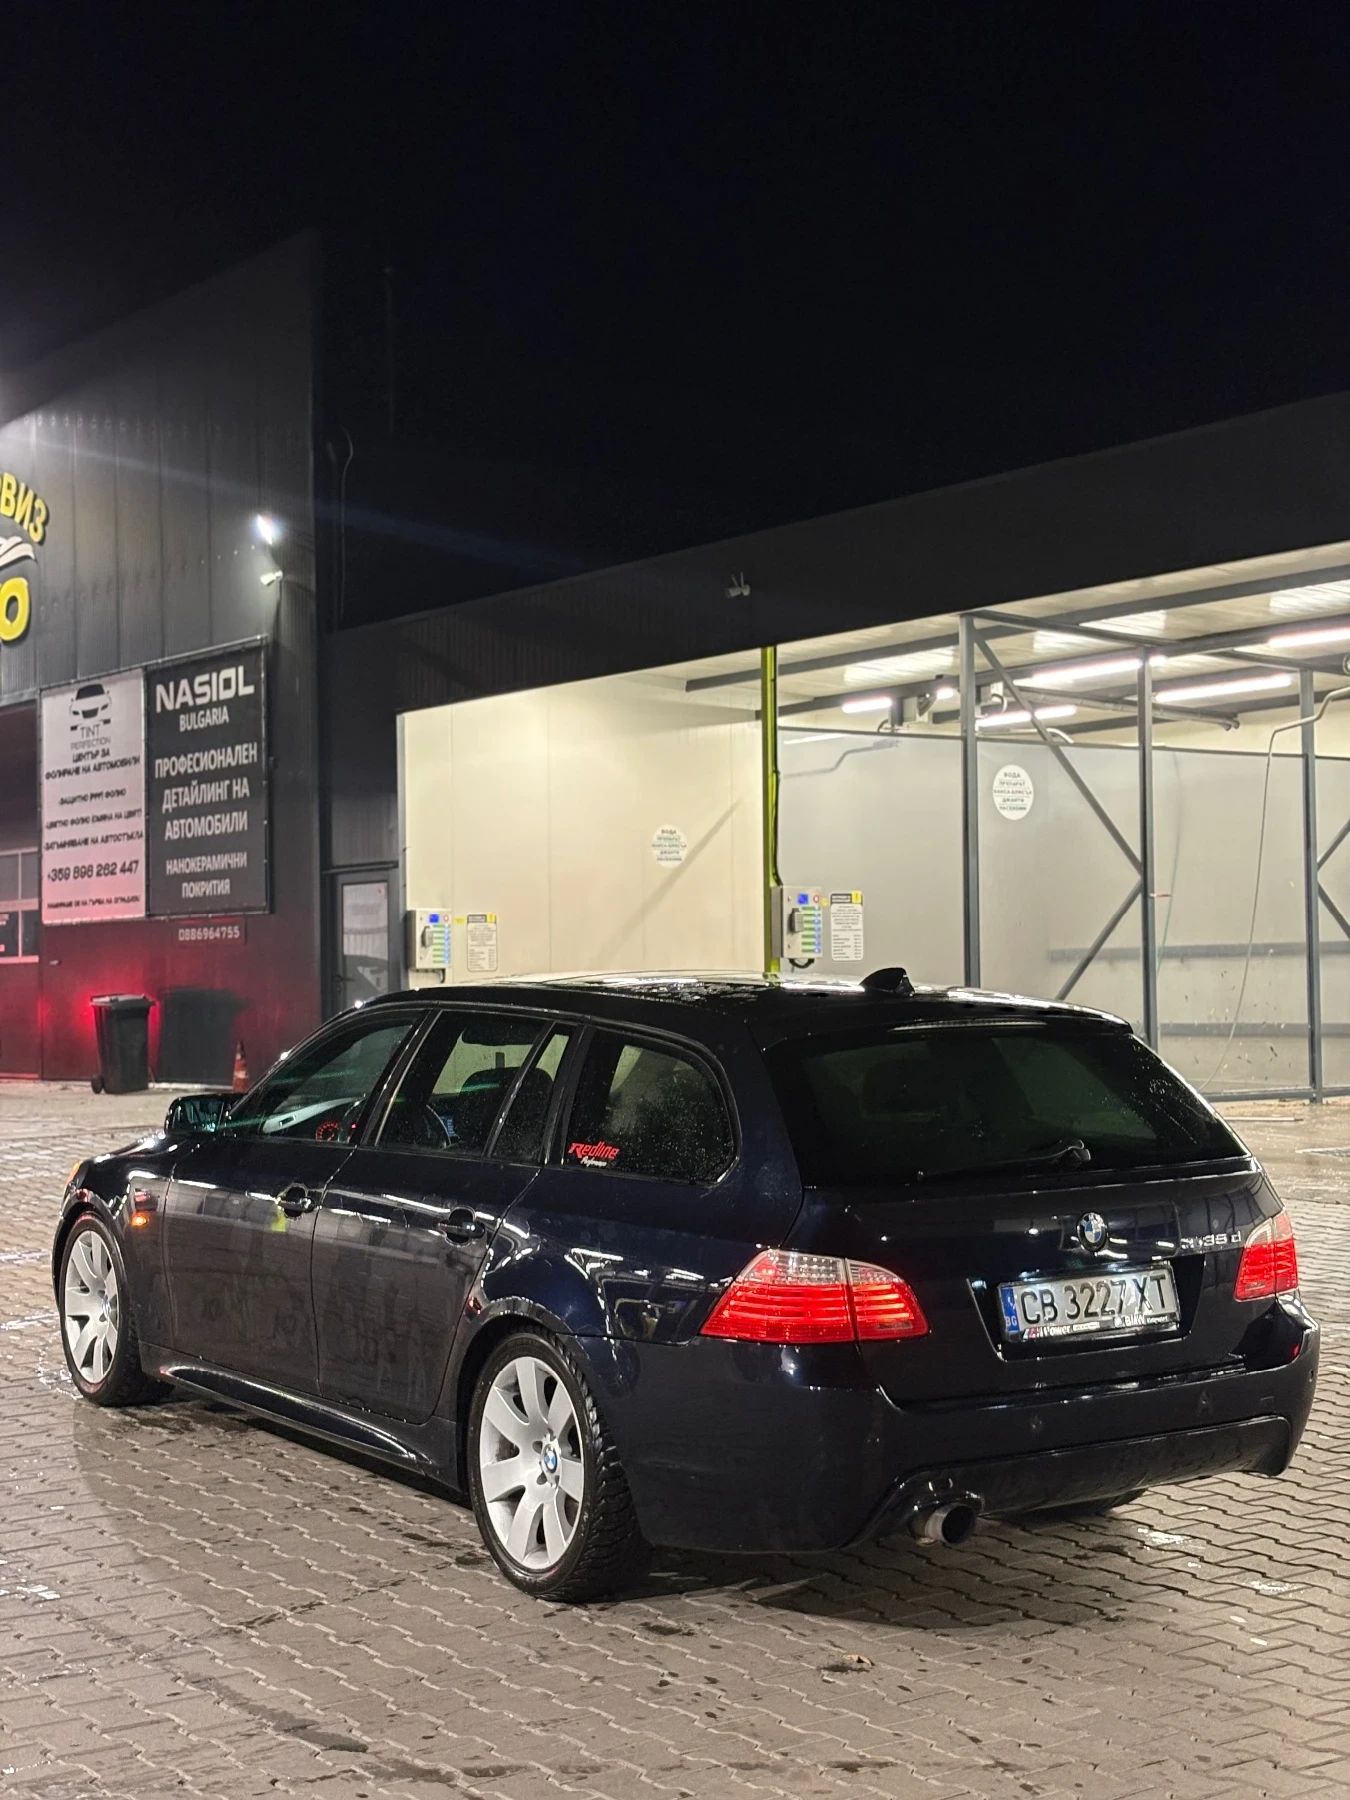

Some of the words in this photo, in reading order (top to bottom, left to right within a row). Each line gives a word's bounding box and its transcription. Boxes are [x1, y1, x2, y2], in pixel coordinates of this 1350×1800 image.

[0, 472, 47, 543] ВИЗ
[156, 665, 255, 714] NASIOL
[179, 705, 230, 732] BULGARIA
[80, 724, 101, 738] TINT
[82, 764, 92, 775] НА
[155, 742, 258, 779] ПРОФЕСИОНАЛЕН
[162, 780, 231, 814] ДЕТАЙЛИНГ
[232, 777, 250, 800] НА
[164, 810, 248, 841] АВТОМОБИЛИ
[119, 859, 139, 875] 447
[166, 851, 248, 875] НАНОКЕРАМИЧНИ
[182, 878, 231, 898] ПОКРИТИЯ
[177, 926, 241, 942] 0886964755
[568, 1141, 620, 1160] Redline
[1020, 1288, 1059, 1325] CB
[1063, 1279, 1127, 1320] 3227
[1132, 1274, 1167, 1313] XT
[1005, 1315, 1018, 1328] BG
